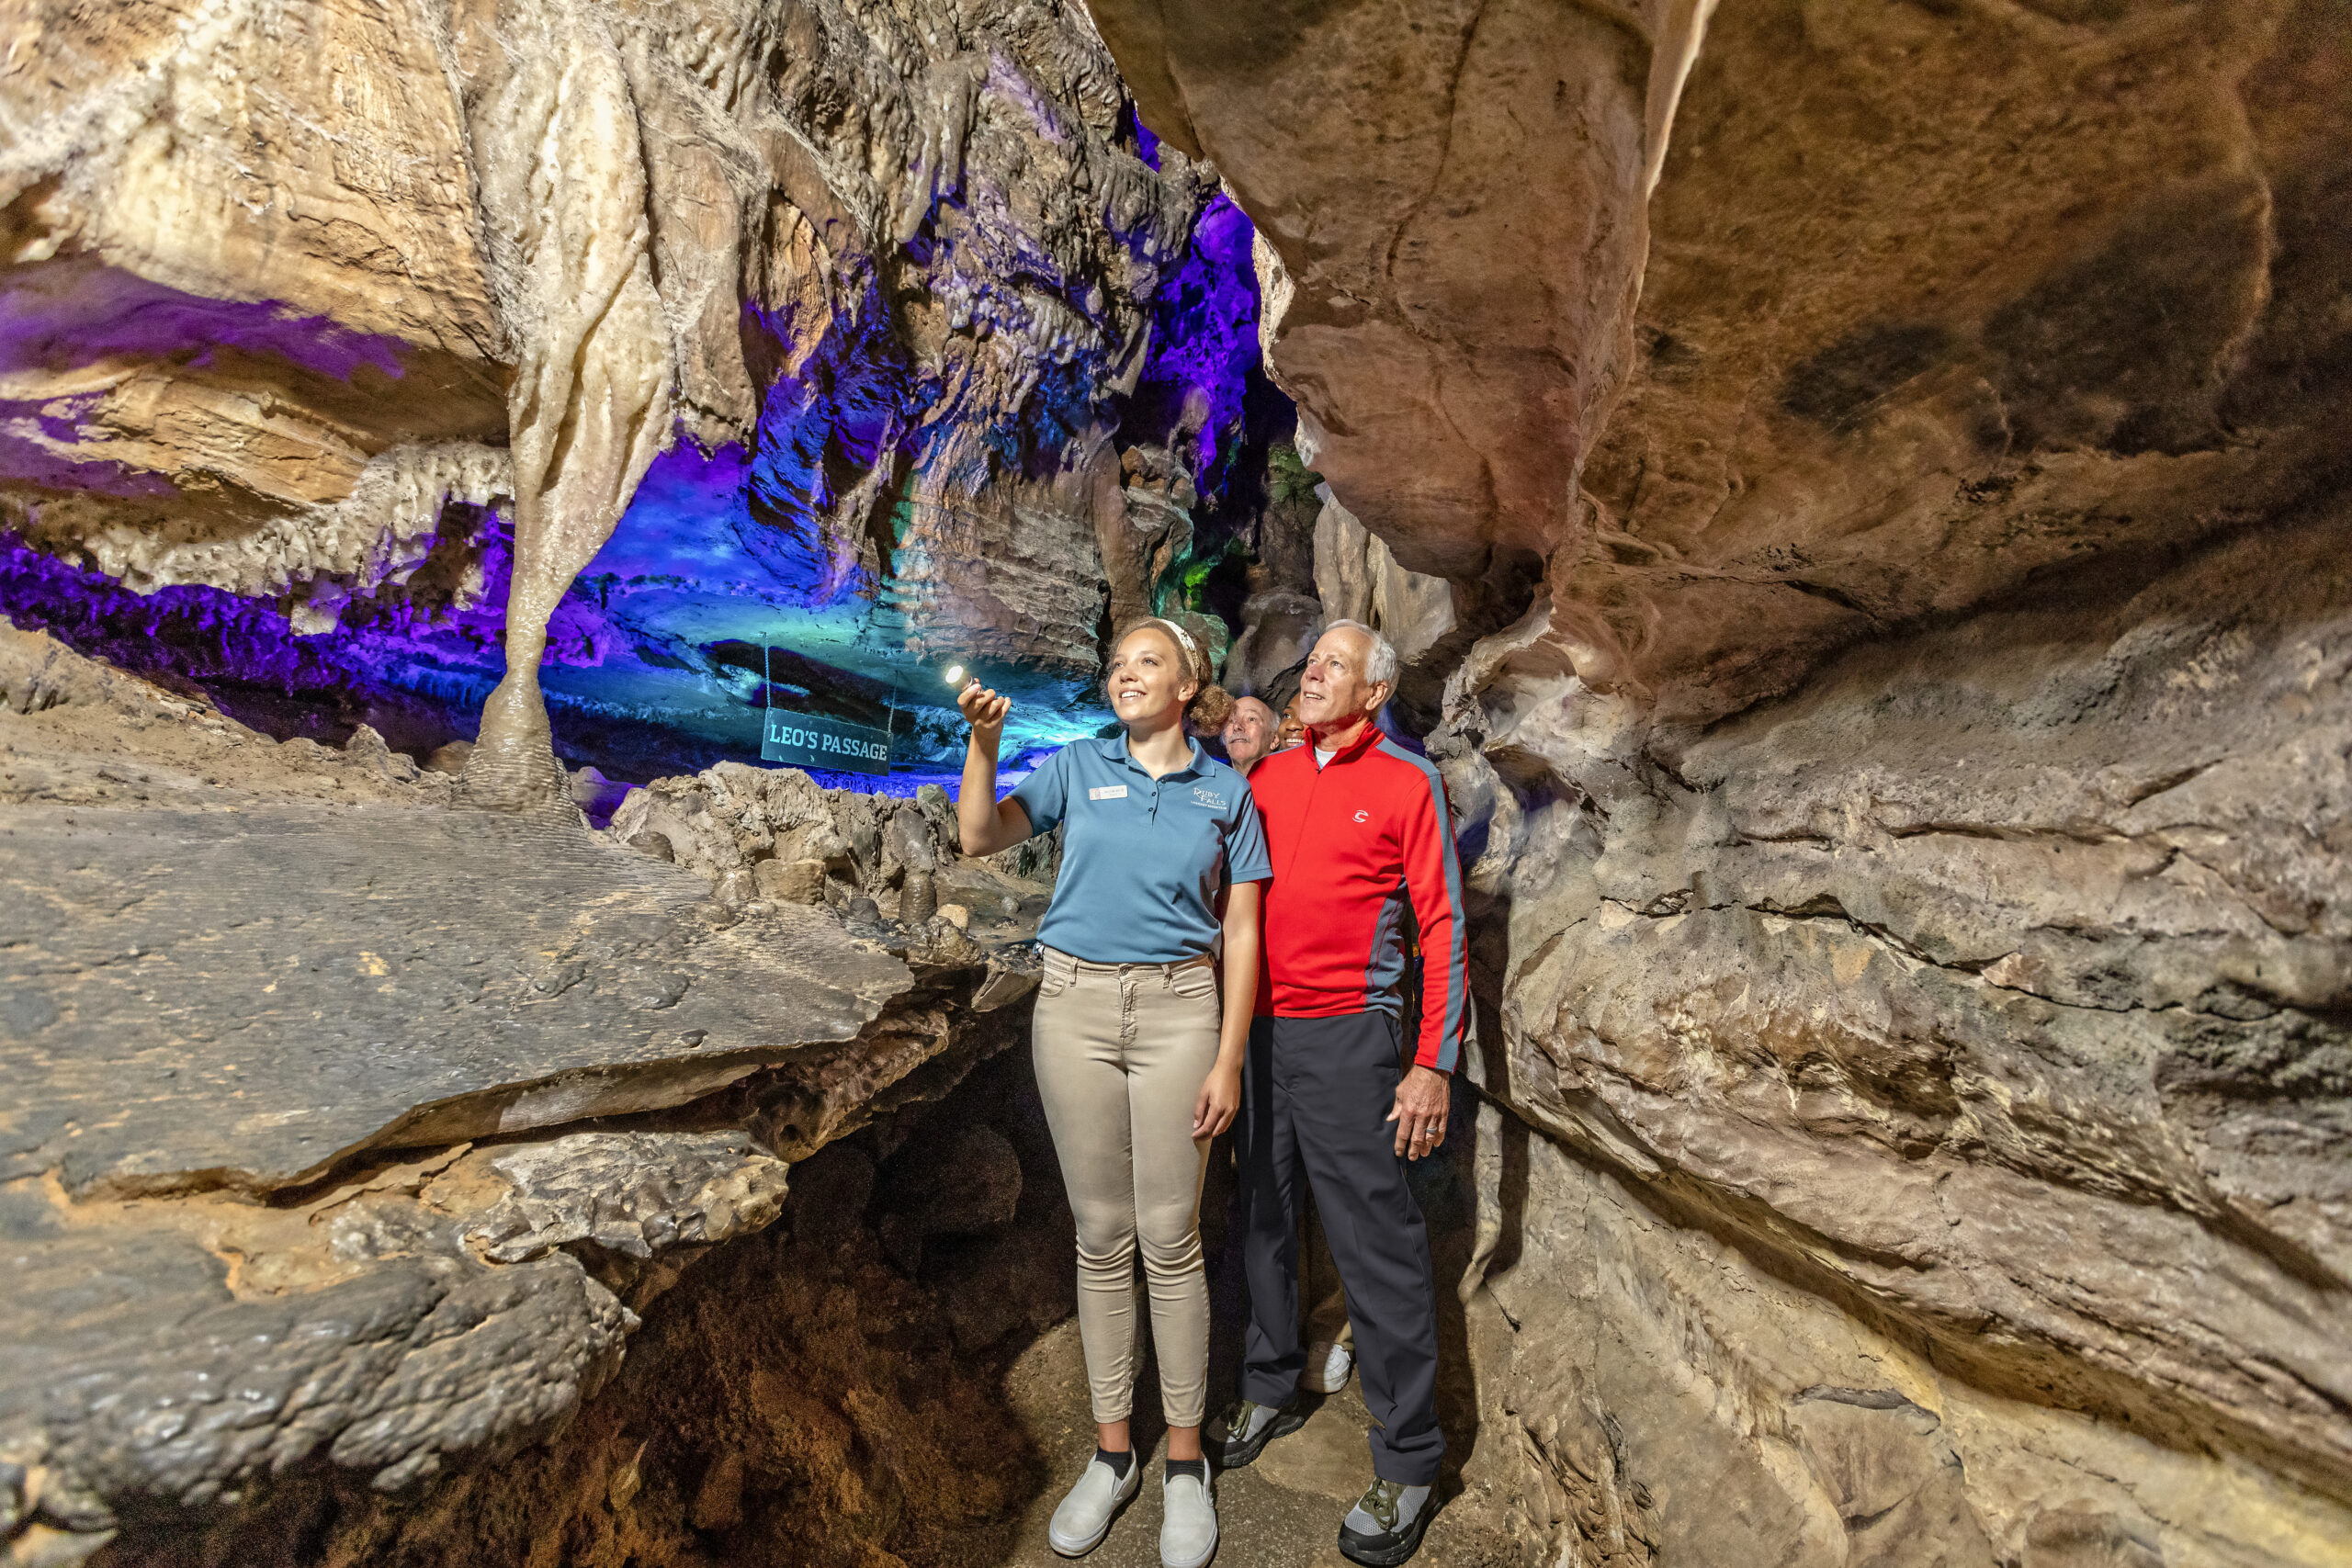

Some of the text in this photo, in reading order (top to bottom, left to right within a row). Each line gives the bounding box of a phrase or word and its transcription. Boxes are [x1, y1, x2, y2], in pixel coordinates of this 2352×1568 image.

[769, 724, 888, 761] LEO'S PASSAGE
[1193, 787, 1220, 799] RUBY
[1201, 795, 1227, 806] FALLS
